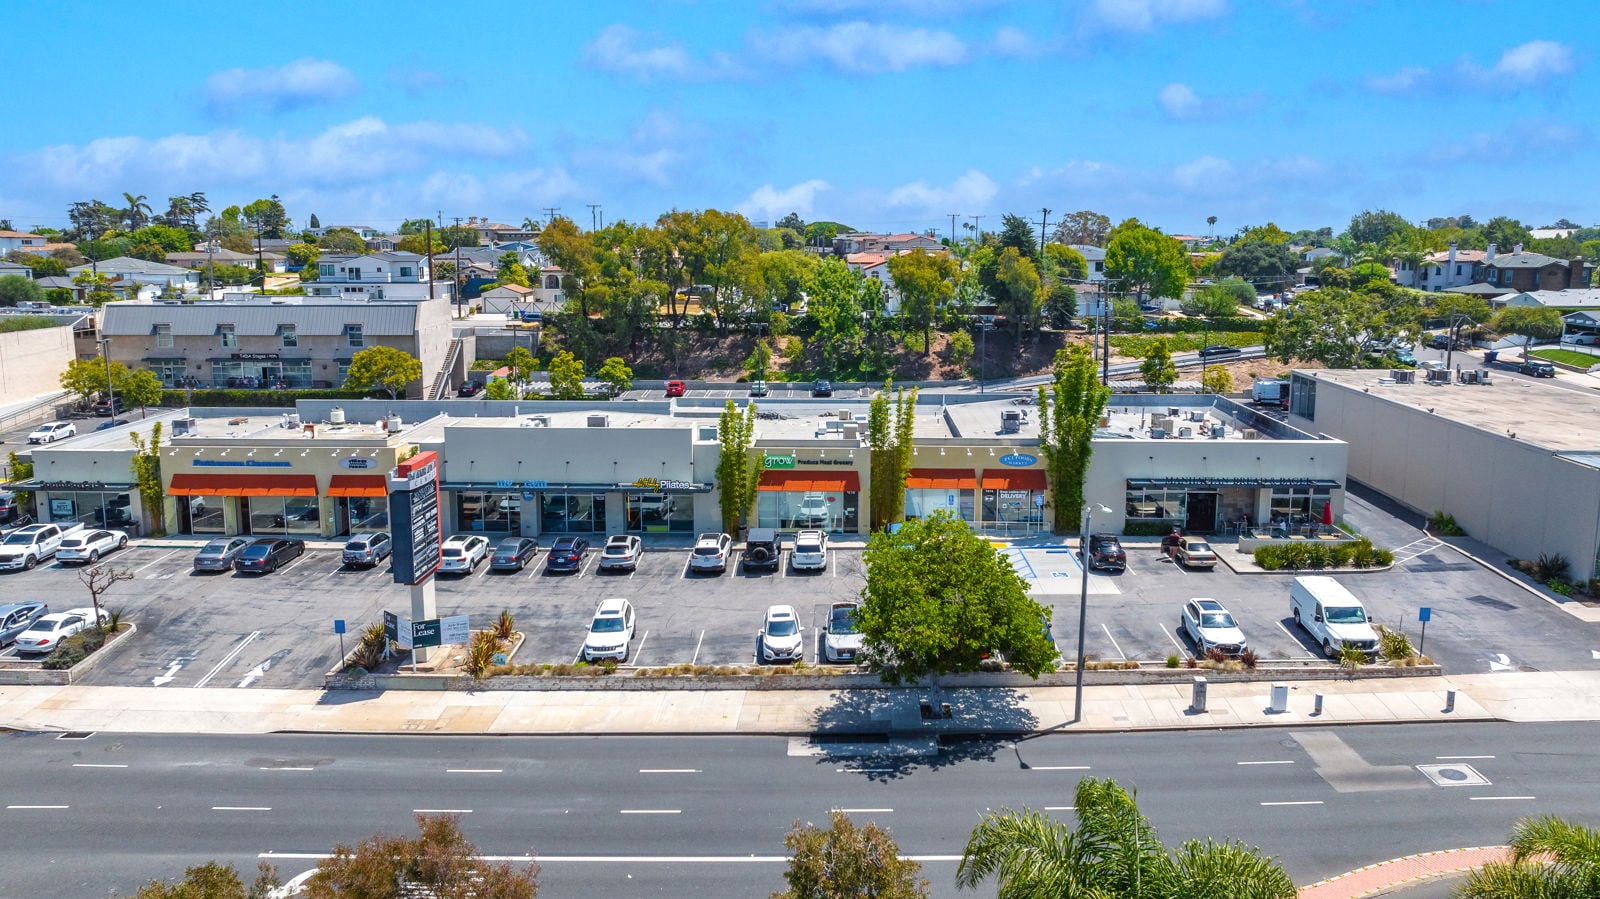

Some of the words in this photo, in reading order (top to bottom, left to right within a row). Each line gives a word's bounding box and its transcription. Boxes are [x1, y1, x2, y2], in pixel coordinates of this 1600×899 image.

[765, 456, 794, 468] grow
[660, 480, 690, 489] Pilates
[413, 622, 427, 632] For
[413, 629, 436, 638] Lease
